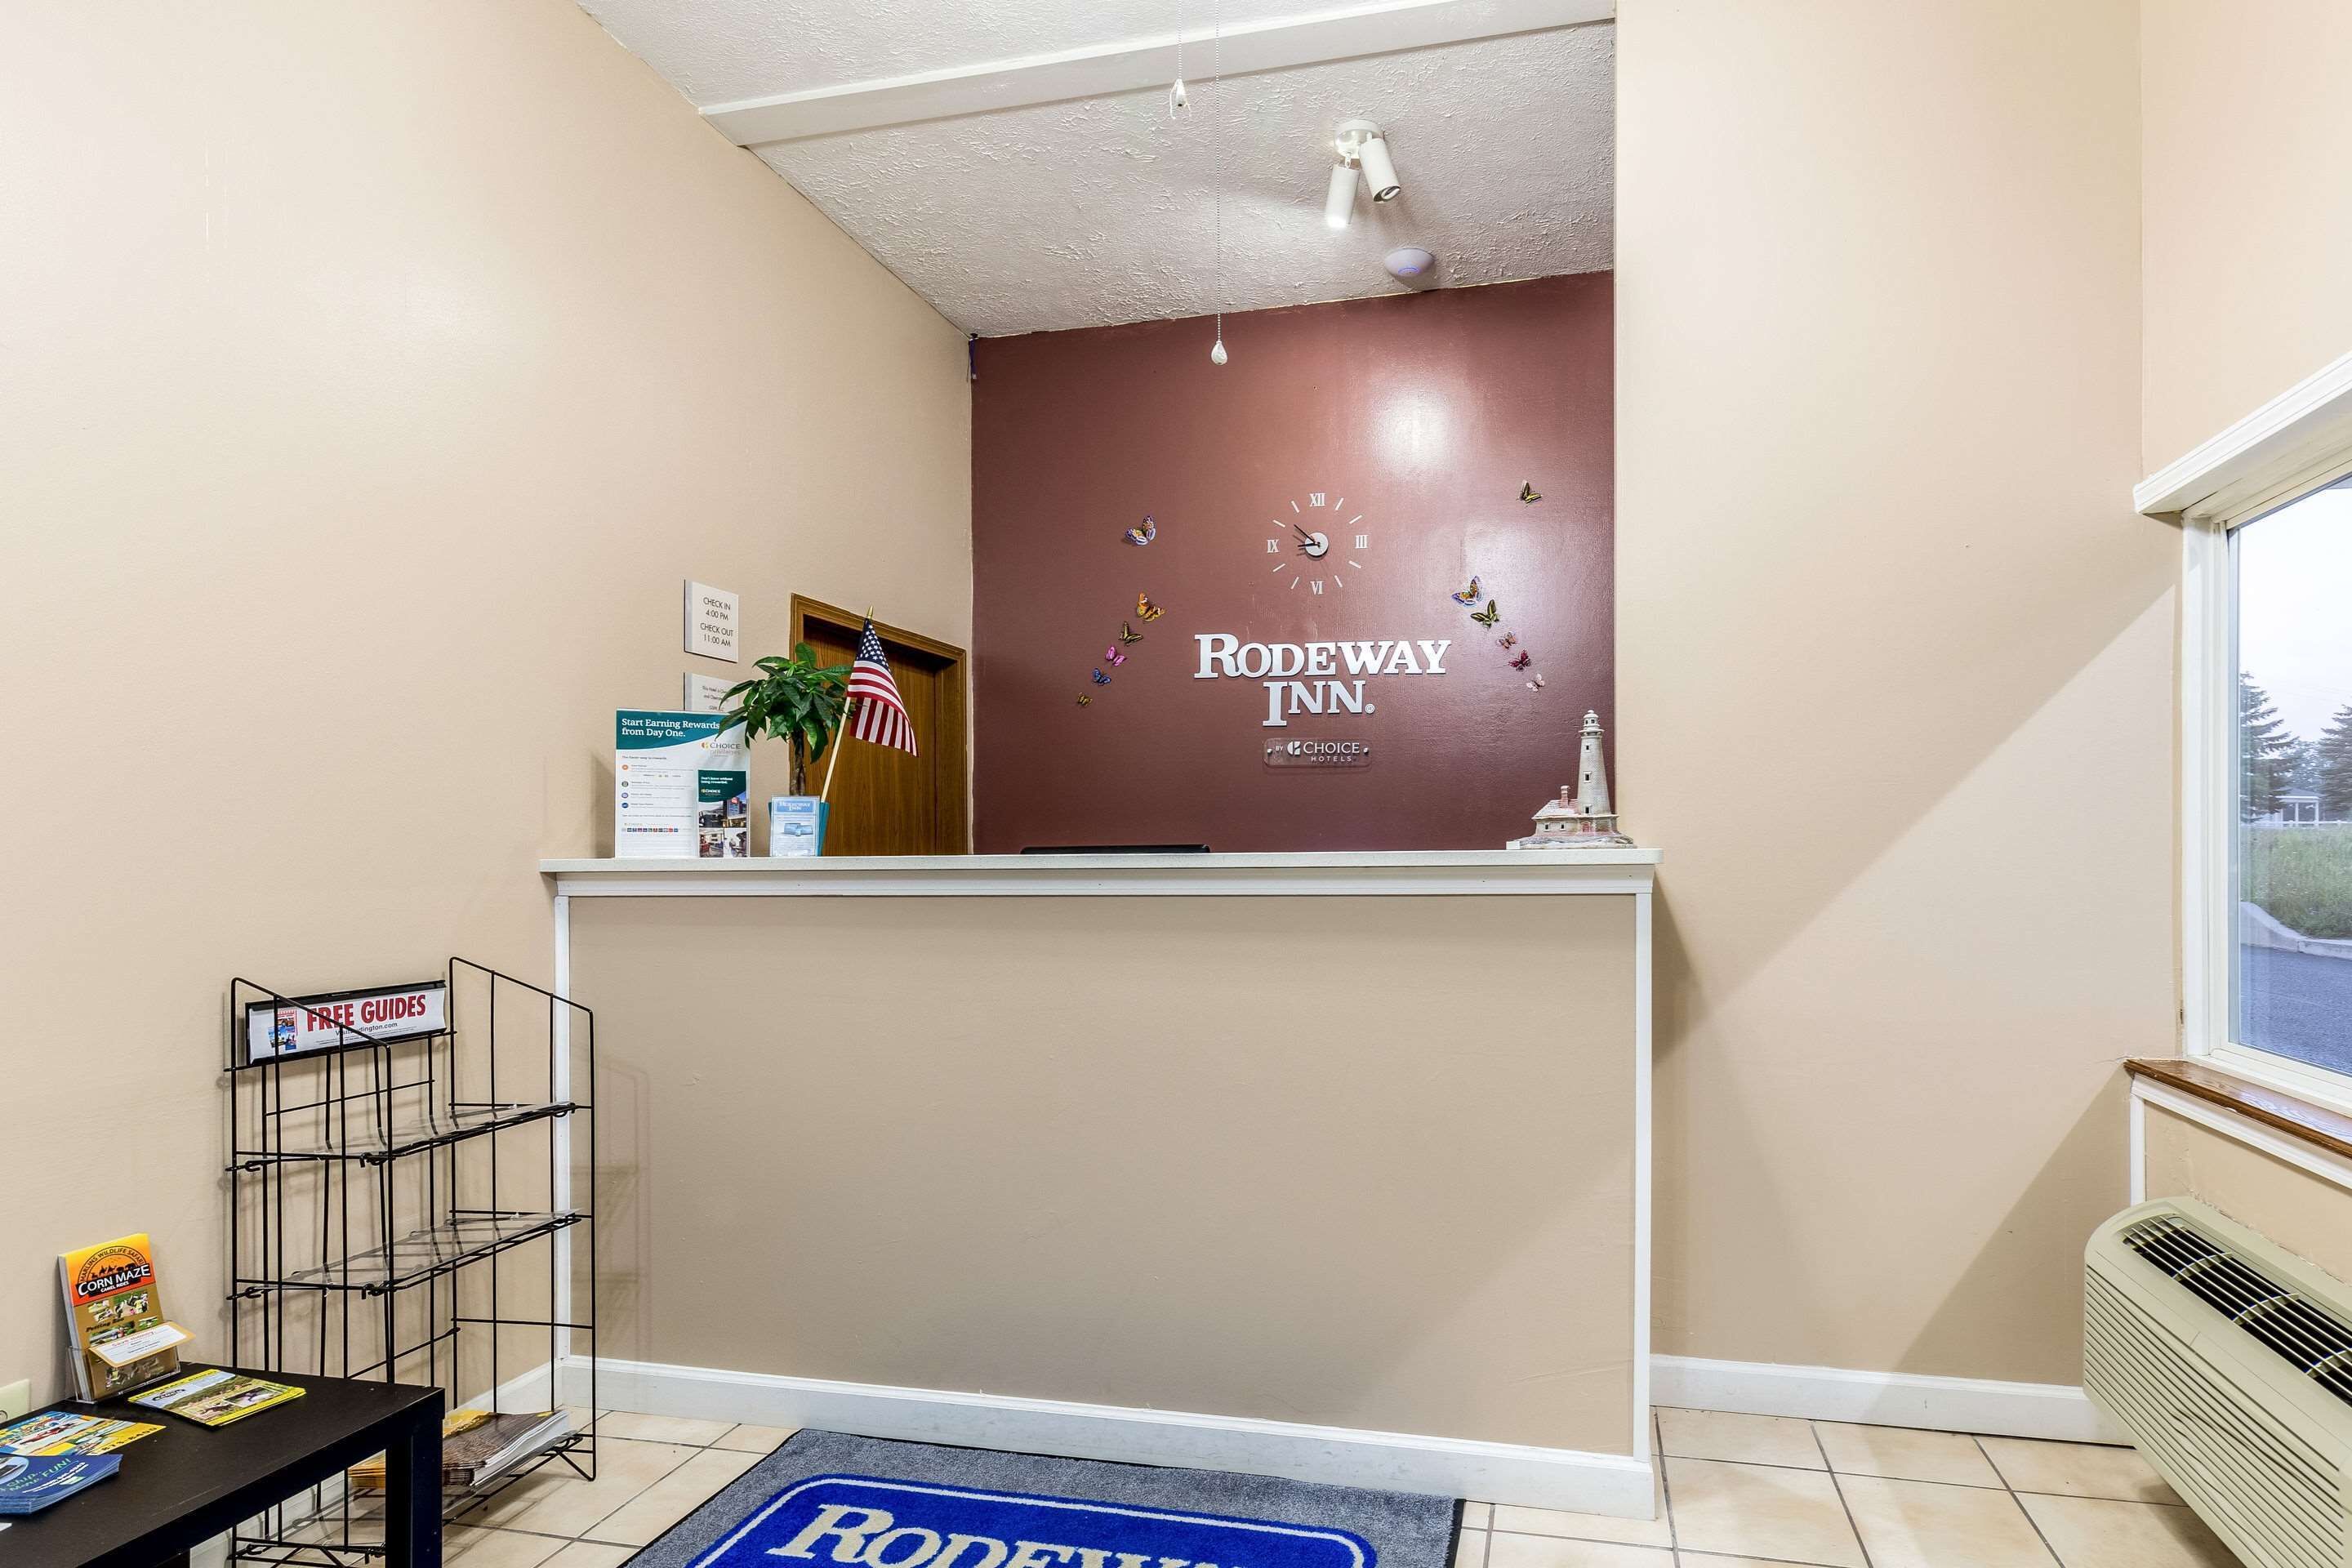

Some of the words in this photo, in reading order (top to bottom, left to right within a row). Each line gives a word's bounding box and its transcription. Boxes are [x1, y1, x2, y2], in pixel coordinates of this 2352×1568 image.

[1308, 492, 1325, 508] XII
[1267, 538, 1279, 555] IX
[1355, 534, 1369, 549] III
[1311, 580, 1324, 595] VI
[703, 597, 723, 608] CHECK
[706, 608, 719, 618] 4:00
[719, 612, 728, 621] PM
[700, 622, 719, 634] CHECK
[721, 628, 733, 637] OUT
[704, 634, 719, 644] 11:00
[721, 638, 731, 647] AM
[621, 718, 643, 727] Start
[645, 719, 681, 729] Earning
[683, 720, 720, 729] Rewards
[621, 727, 644, 736] from
[646, 728, 664, 738] Day
[665, 729, 686, 737] One.
[710, 742, 742, 750] CHOICE
[1303, 741, 1360, 755] CHOICE
[307, 1003, 355, 1032] FREE
[360, 994, 426, 1024] GUIDES
[98, 1246, 127, 1258] WILDLIFE
[127, 1249, 145, 1265] SAFARI
[78, 1275, 113, 1296] CORN
[116, 1263, 151, 1284] MAZE
[100, 1285, 116, 1294] CAMEL
